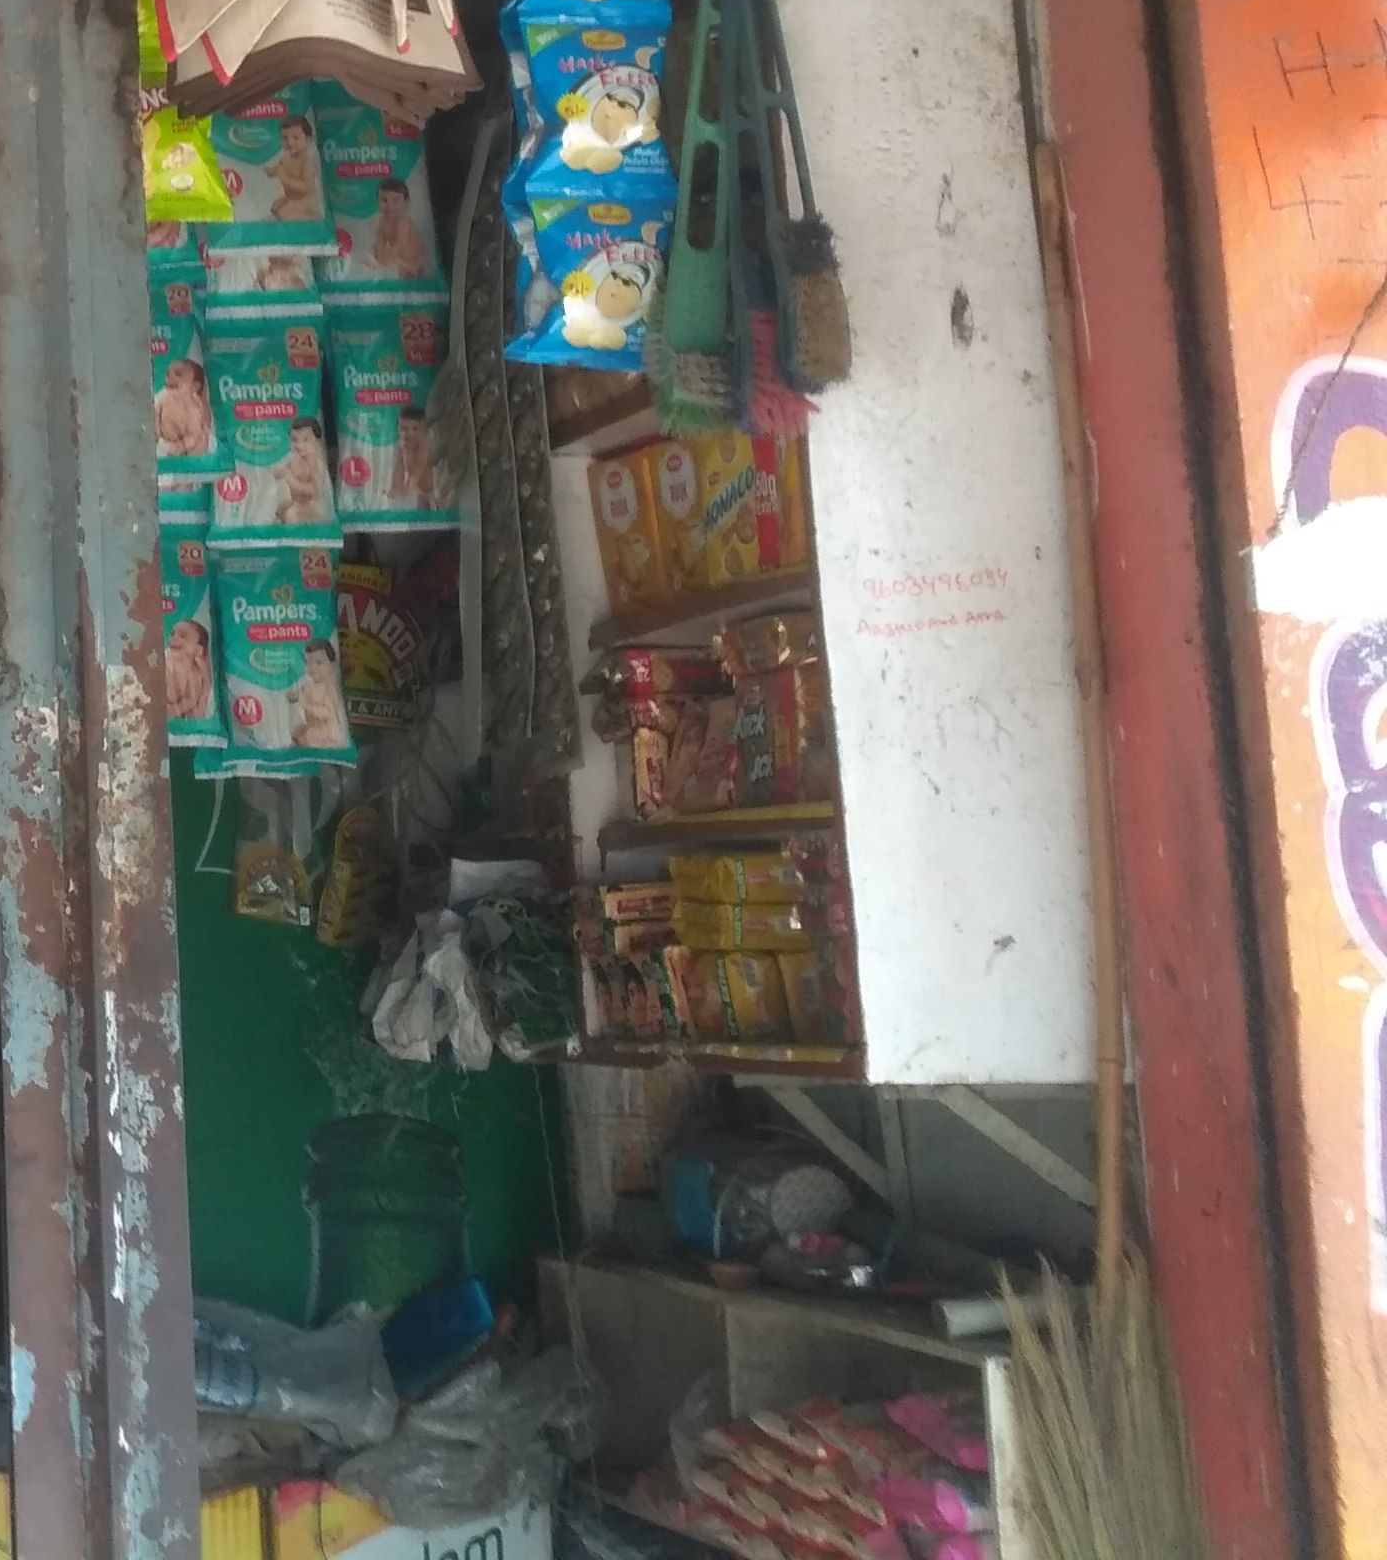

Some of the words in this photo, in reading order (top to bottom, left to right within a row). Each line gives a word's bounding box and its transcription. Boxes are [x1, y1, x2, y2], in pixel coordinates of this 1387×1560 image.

[288, 334, 314, 351] 24
[343, 364, 418, 388] Pampers
[218, 375, 303, 400] Pampers
[254, 403, 294, 419] pants
[224, 475, 243, 491] M
[302, 555, 327, 571] 24
[232, 596, 317, 623] Pampers
[268, 624, 308, 640] pants
[238, 701, 256, 717] M
